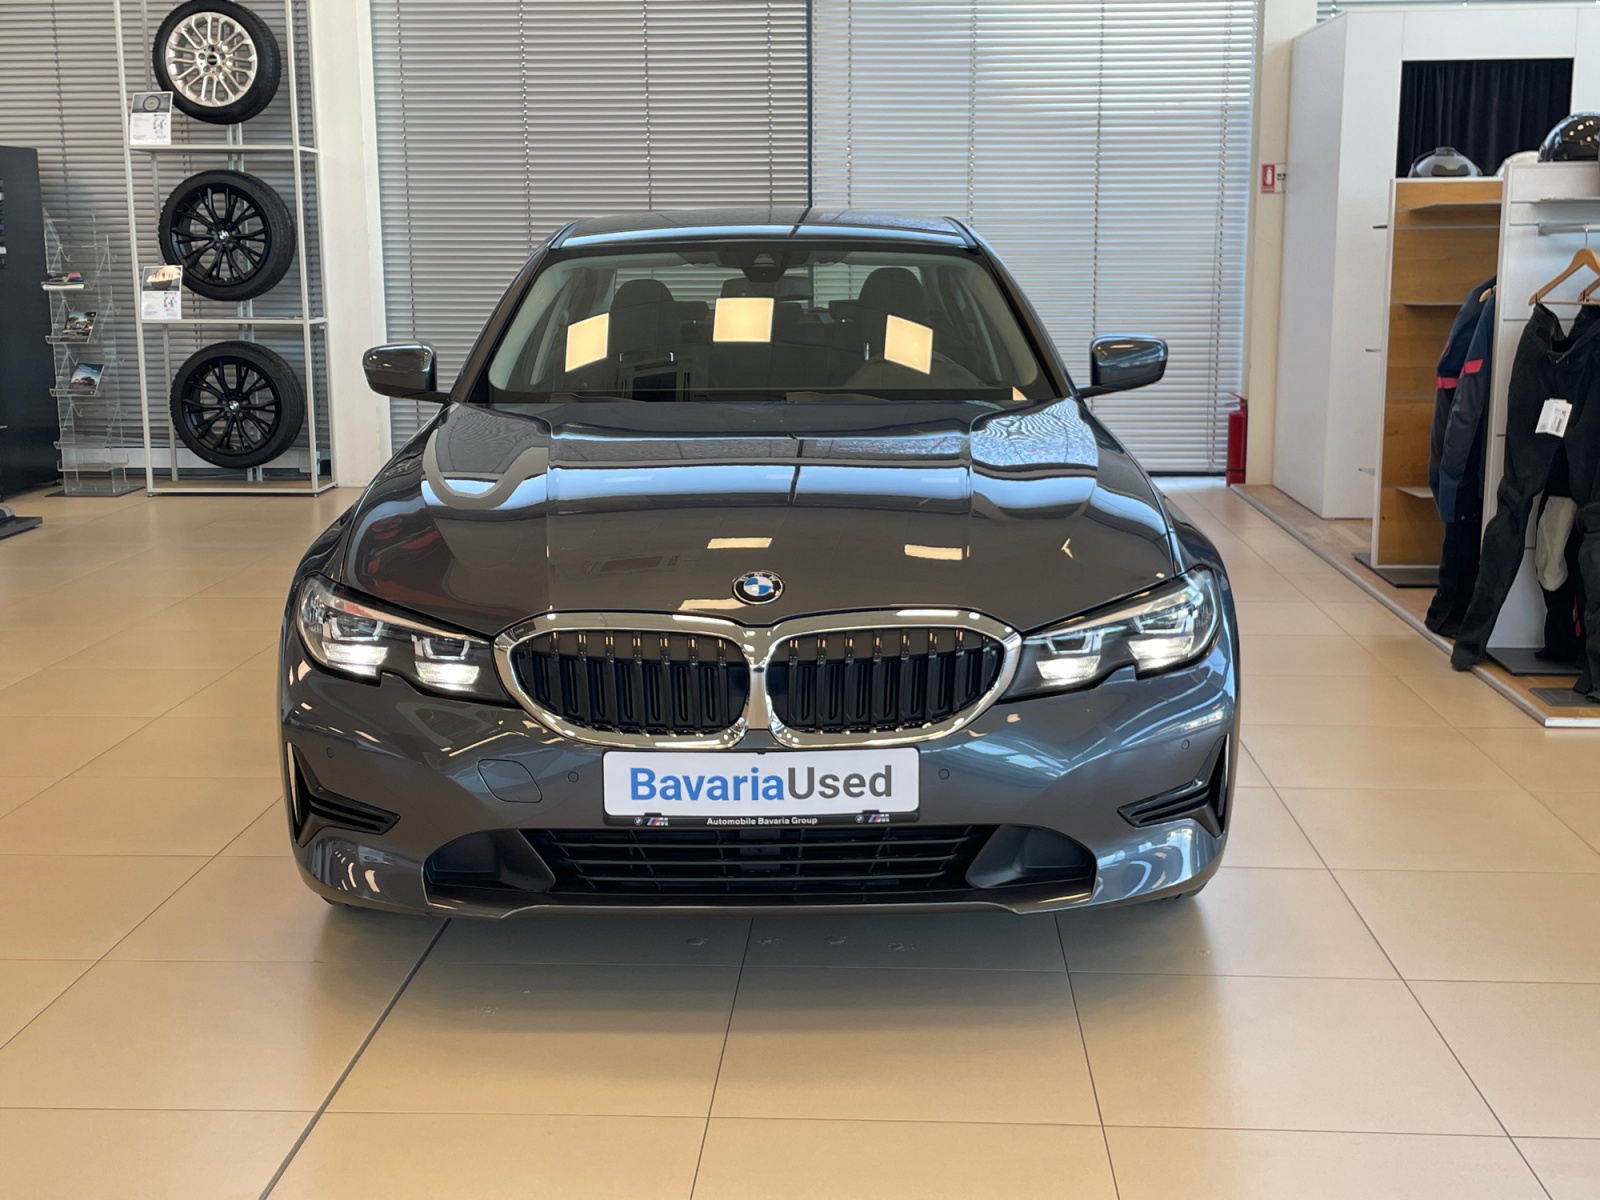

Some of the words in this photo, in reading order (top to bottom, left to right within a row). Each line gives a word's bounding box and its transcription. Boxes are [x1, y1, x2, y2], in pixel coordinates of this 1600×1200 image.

[630, 765, 892, 801] BavariaUsed
[706, 817, 756, 825] Automobile
[757, 817, 790, 825] Bavaria
[791, 816, 818, 825] Group
